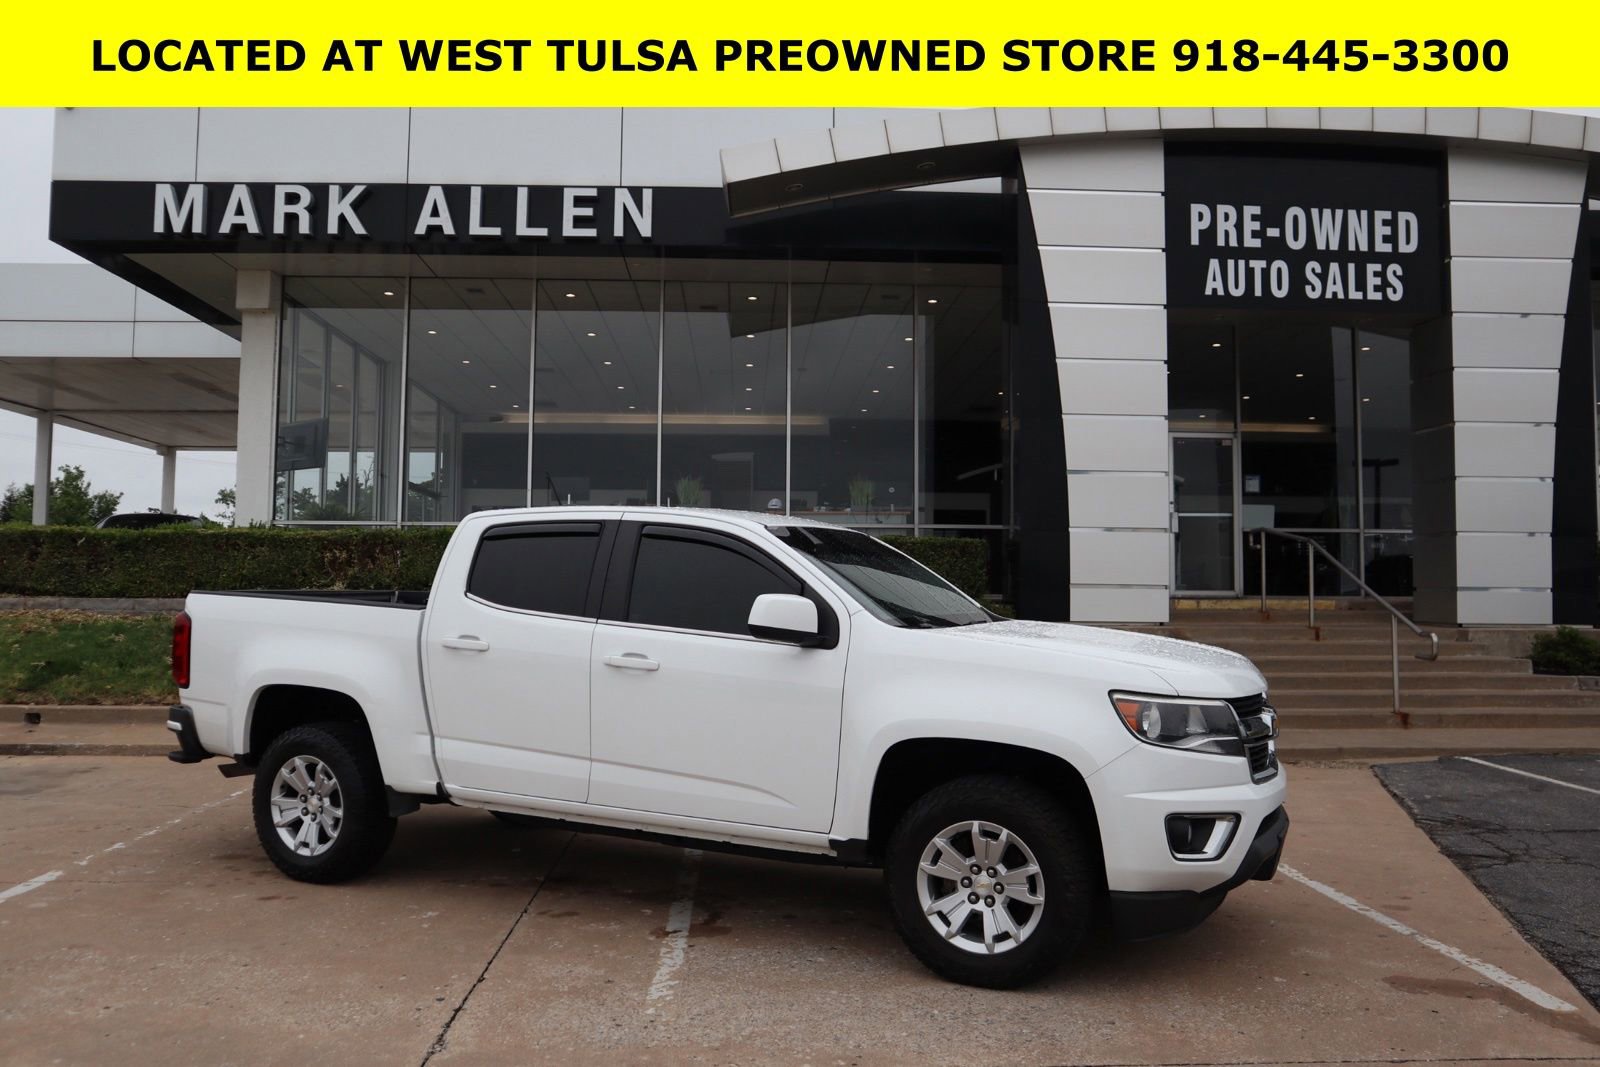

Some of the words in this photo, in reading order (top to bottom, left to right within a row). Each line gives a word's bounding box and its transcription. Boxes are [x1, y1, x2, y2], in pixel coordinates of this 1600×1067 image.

[153, 183, 368, 235] MARK
[414, 185, 653, 238] ALLEN
[1190, 203, 1419, 254] PRE-OWNED
[1204, 258, 1290, 298] AUTO
[1304, 261, 1404, 301] SALES
